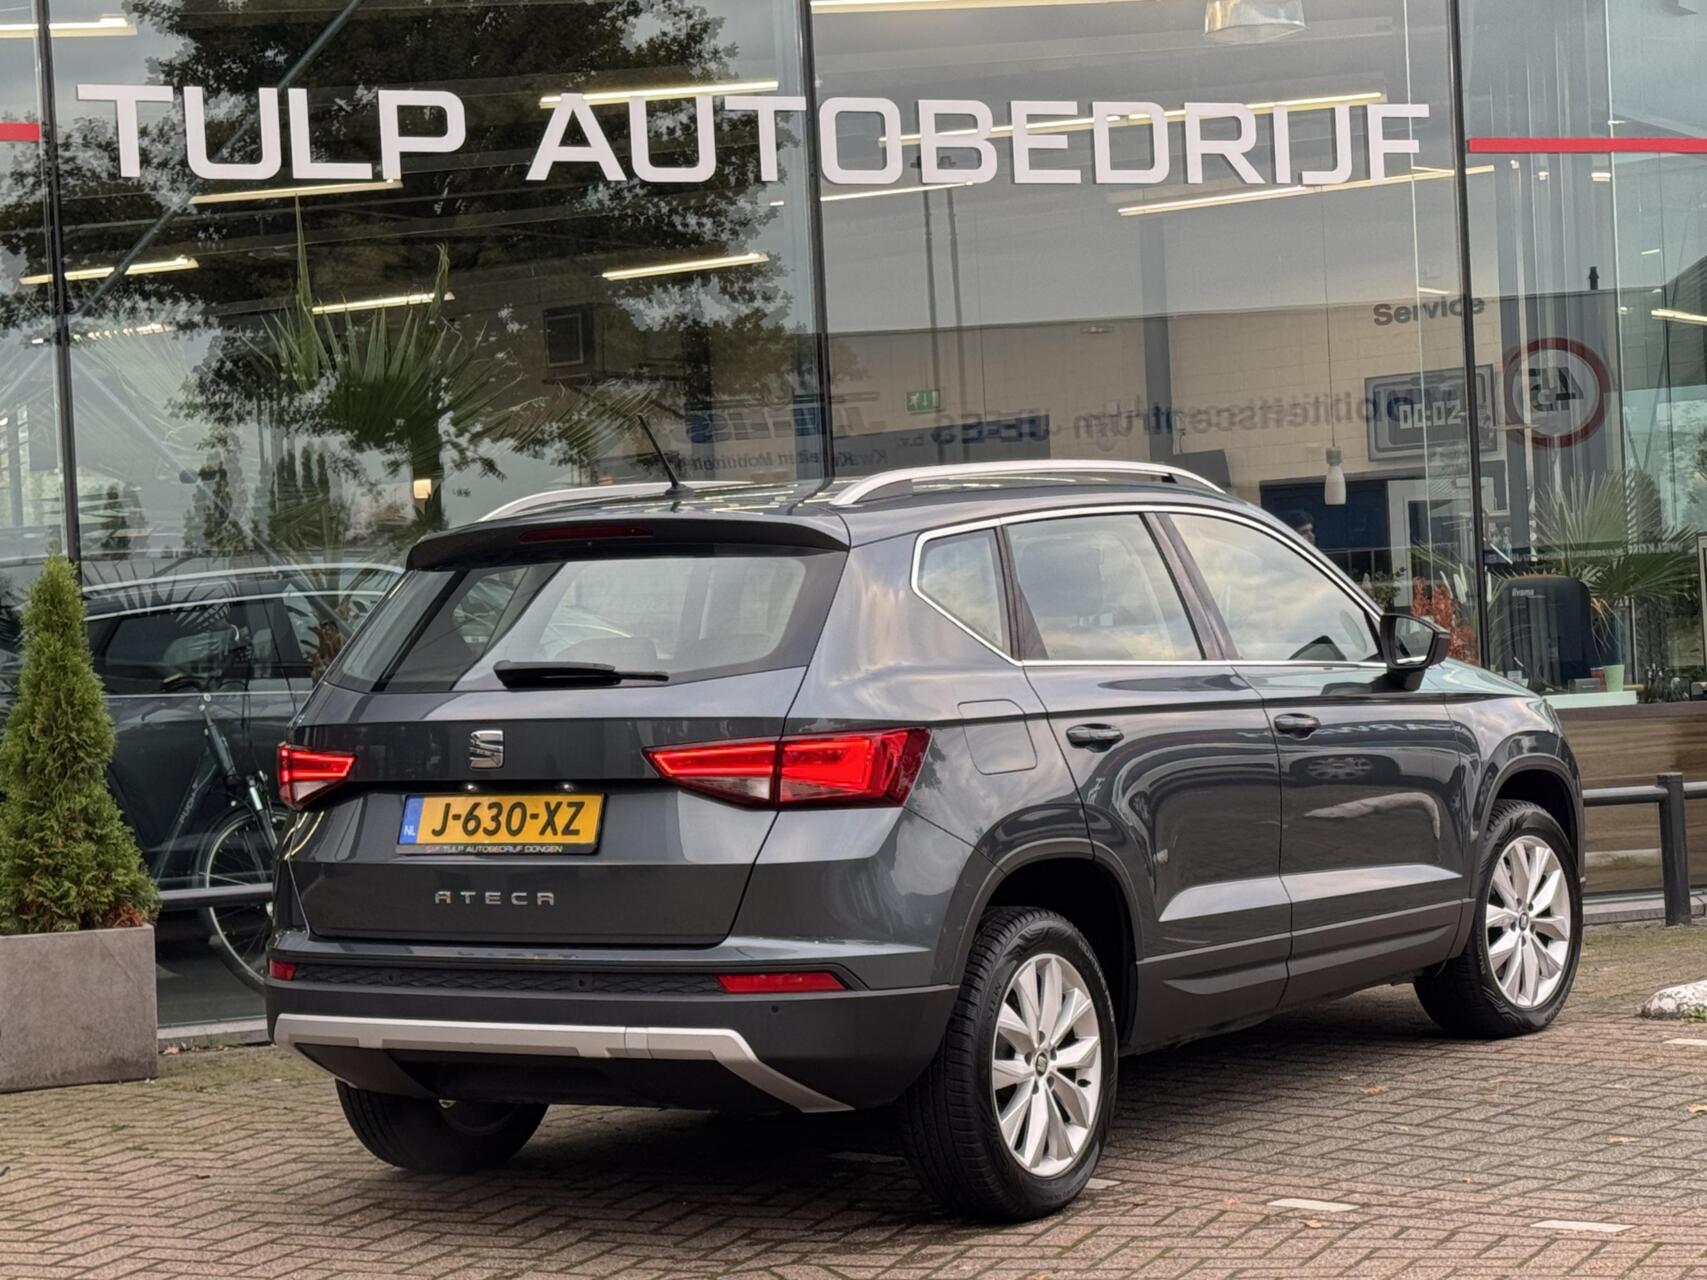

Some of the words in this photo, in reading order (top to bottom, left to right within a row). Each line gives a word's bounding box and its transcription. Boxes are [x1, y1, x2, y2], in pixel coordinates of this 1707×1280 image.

[77, 83, 466, 182] TULP
[525, 92, 1431, 185] AUTOBEDRIJF
[403, 825, 417, 836] NL
[431, 800, 585, 837] J-630-XZ
[435, 890, 555, 906] ATECA
